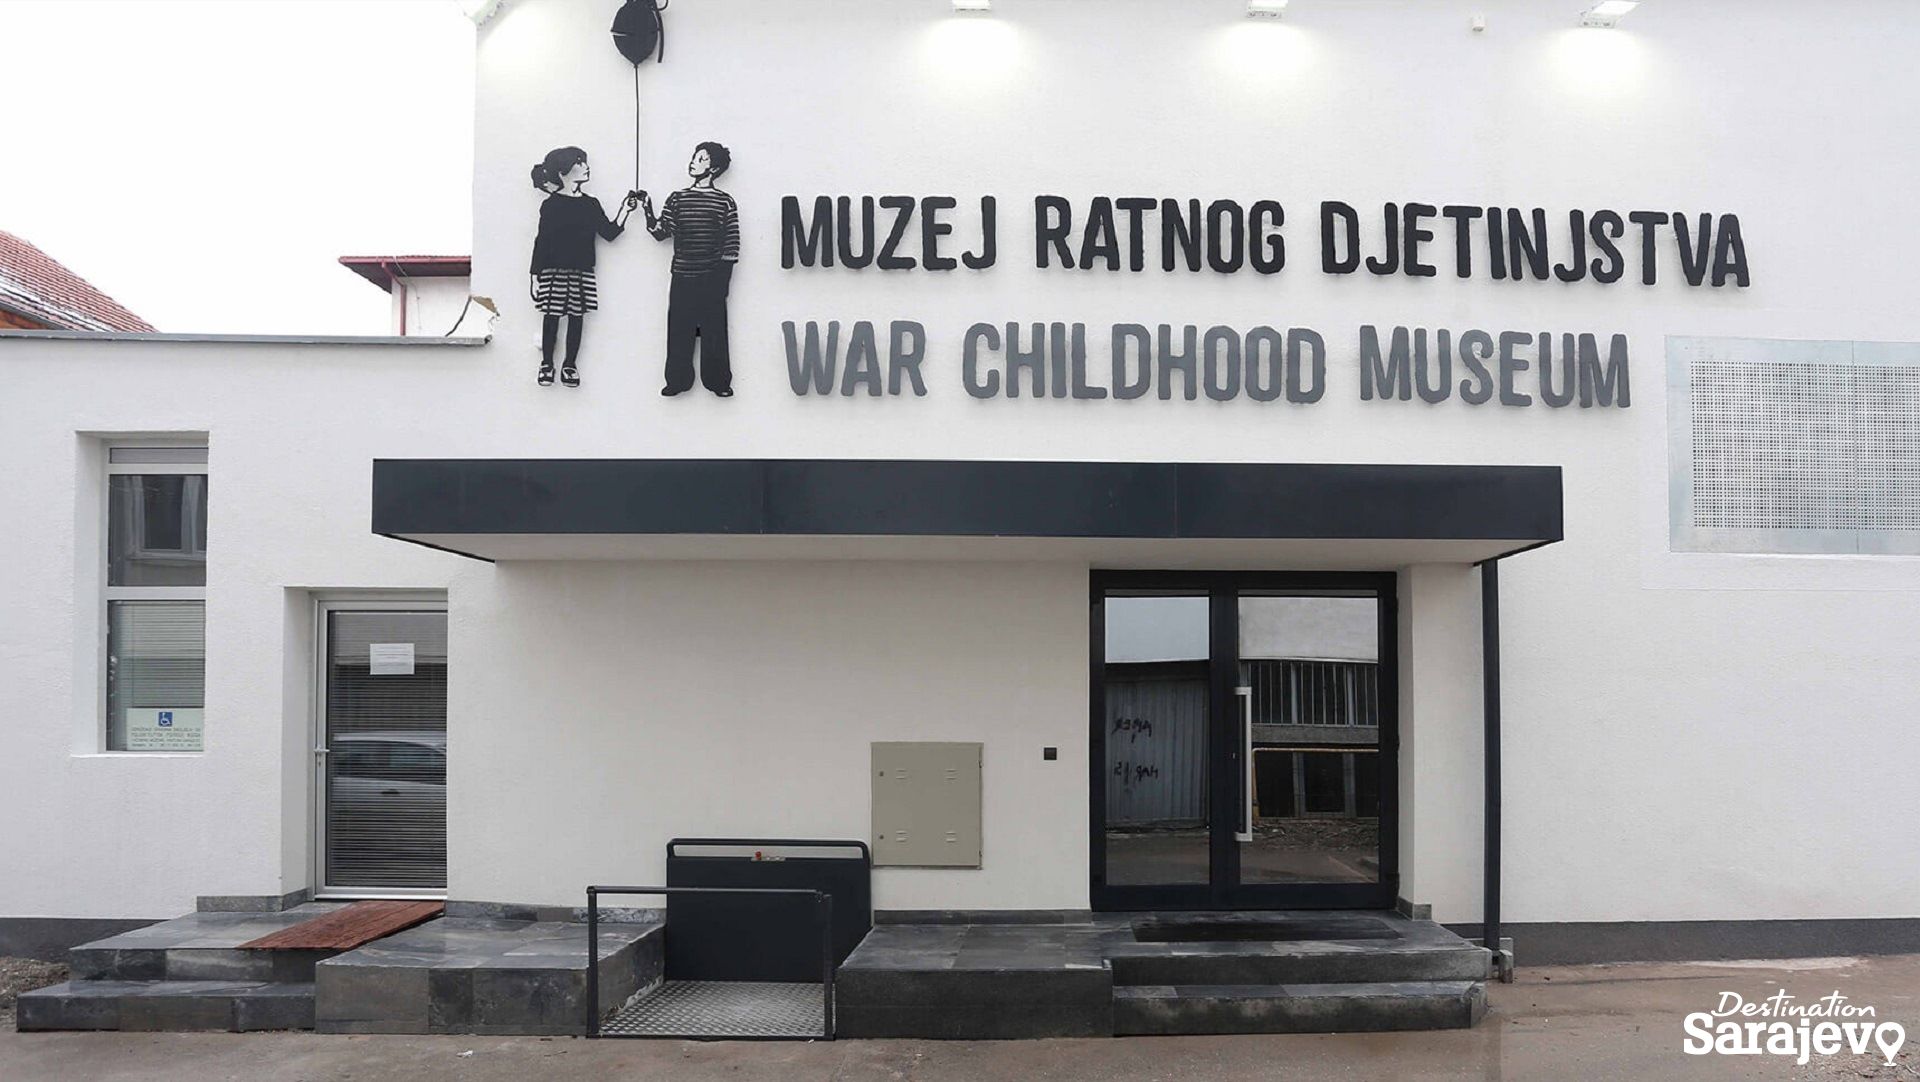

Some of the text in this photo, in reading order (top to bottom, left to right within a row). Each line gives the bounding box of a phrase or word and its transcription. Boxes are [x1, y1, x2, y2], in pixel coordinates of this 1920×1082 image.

[781, 195, 1750, 287] MUZEJ RATNOG DJETINJSTVA
[782, 321, 1630, 409] WAR CHILDHOOD MUSEUM
